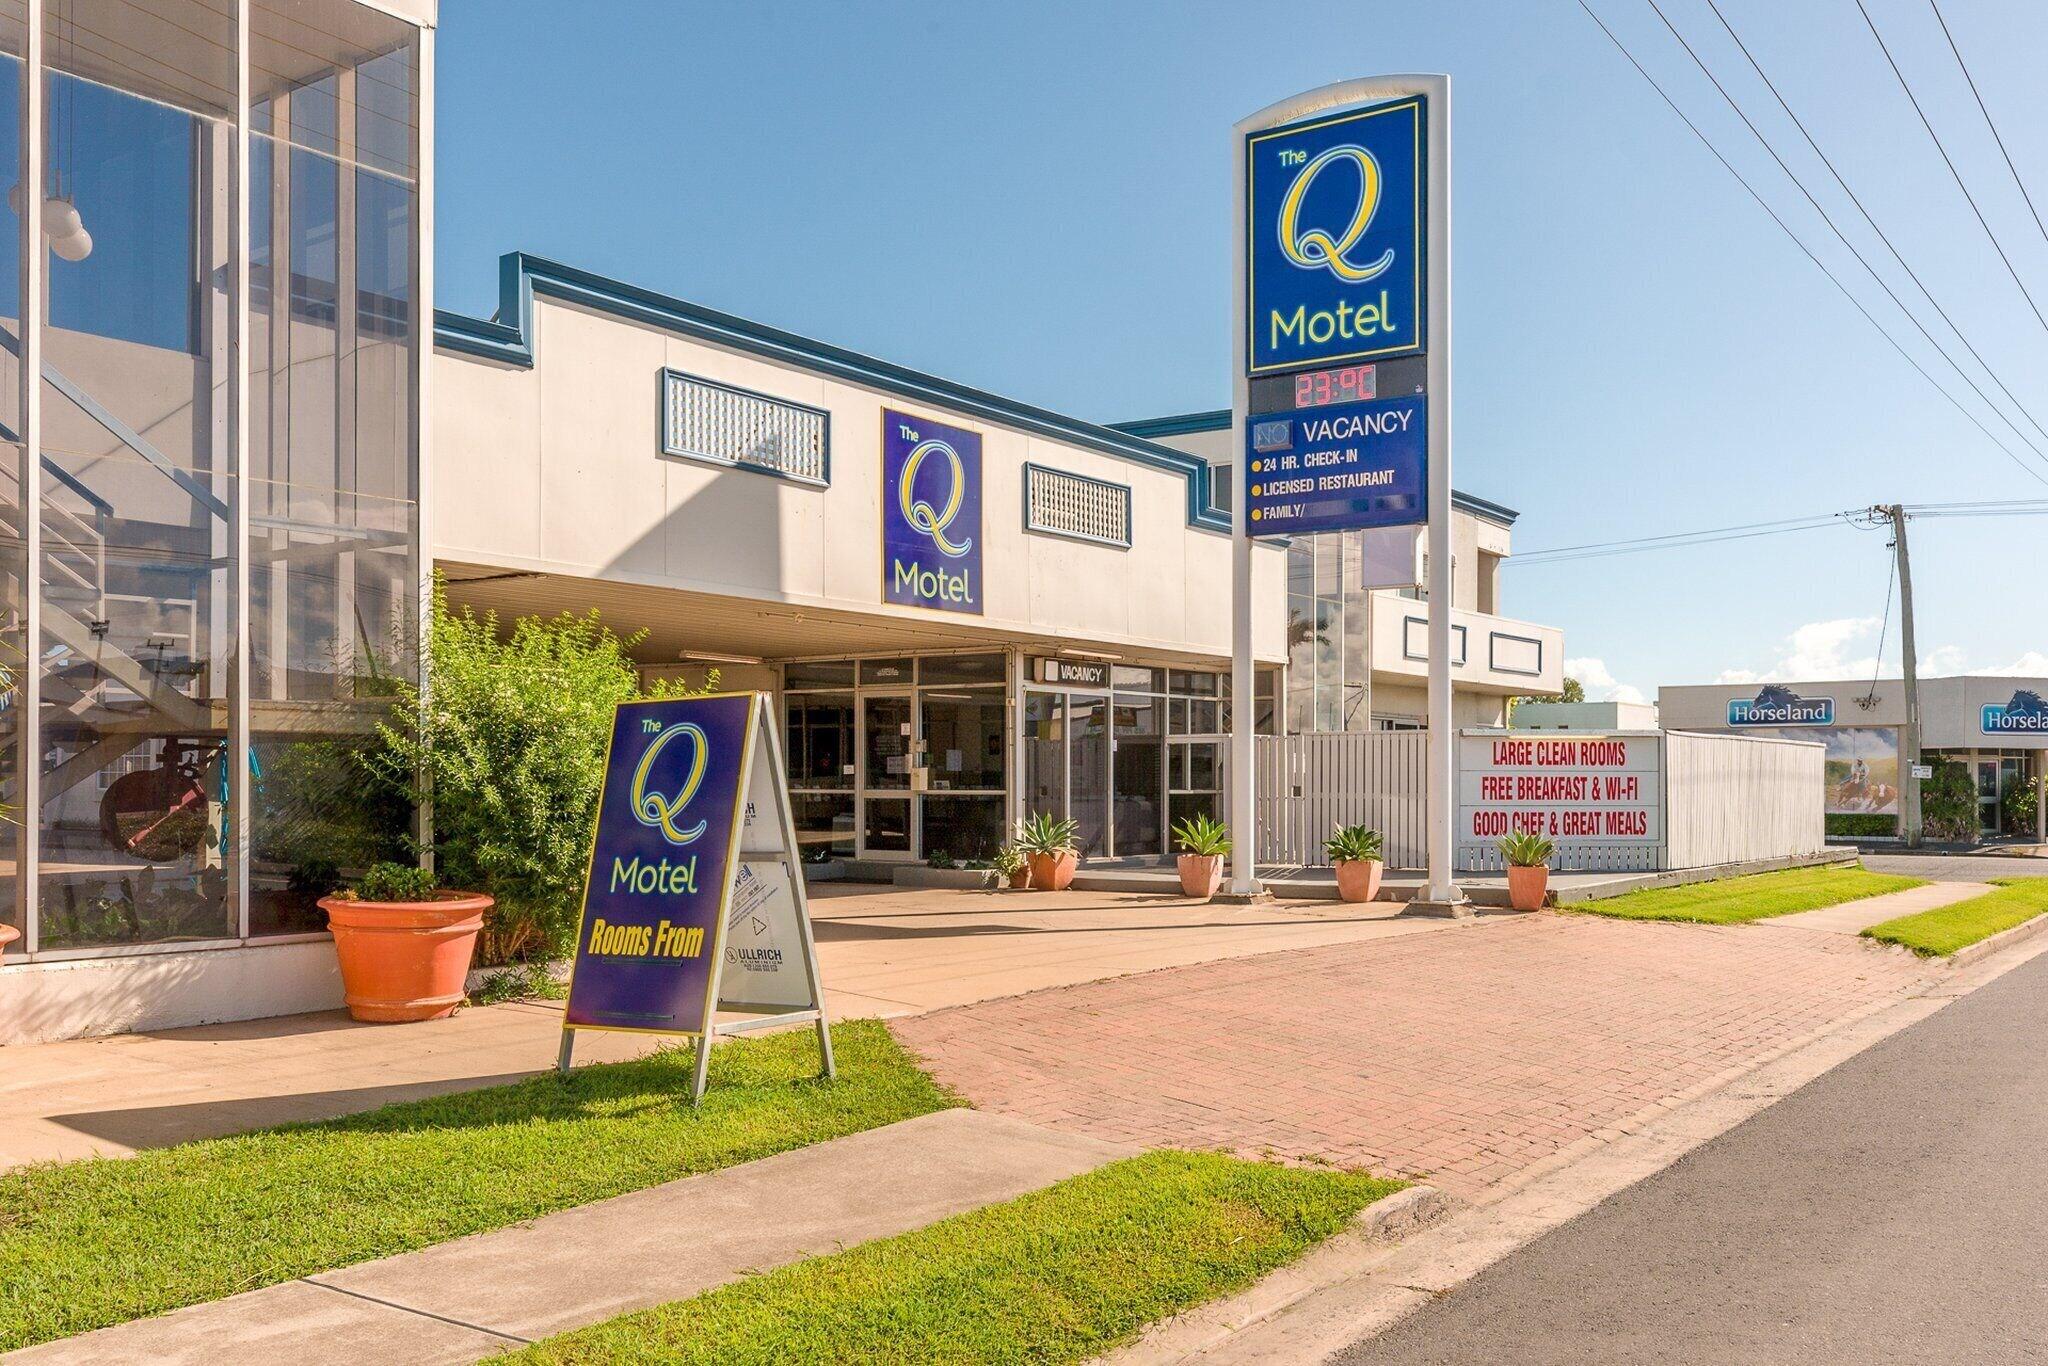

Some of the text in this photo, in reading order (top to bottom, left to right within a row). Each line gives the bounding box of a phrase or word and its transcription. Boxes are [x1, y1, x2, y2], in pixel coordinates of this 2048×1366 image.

[1278, 149, 1307, 167] The
[1277, 144, 1395, 283] Q
[1271, 290, 1395, 350] Motel
[899, 425, 919, 442] The
[1257, 409, 1413, 446] NO VACANCY
[1263, 458, 1277, 472] 24
[1281, 456, 1300, 470] HR.
[1263, 470, 1395, 497] LICENSED RESTAURANT
[899, 439, 972, 557] Q
[1263, 503, 1305, 520] FAMILY/
[894, 559, 973, 604] Motel
[1061, 664, 1102, 682] VACANCY
[1734, 703, 1827, 721] Horseland
[642, 719, 662, 733] The
[1493, 741, 1626, 766] LARGE CLEAN ROOMS
[630, 722, 709, 846] Q
[1482, 776, 1638, 801] FREE BREAKFAST & WI-FI
[1473, 811, 1647, 836] GOOD CHEF & GREAT MEALS
[610, 856, 698, 895] Motel
[588, 918, 705, 958] Rooms From
[738, 948, 782, 961] ULLRICH
